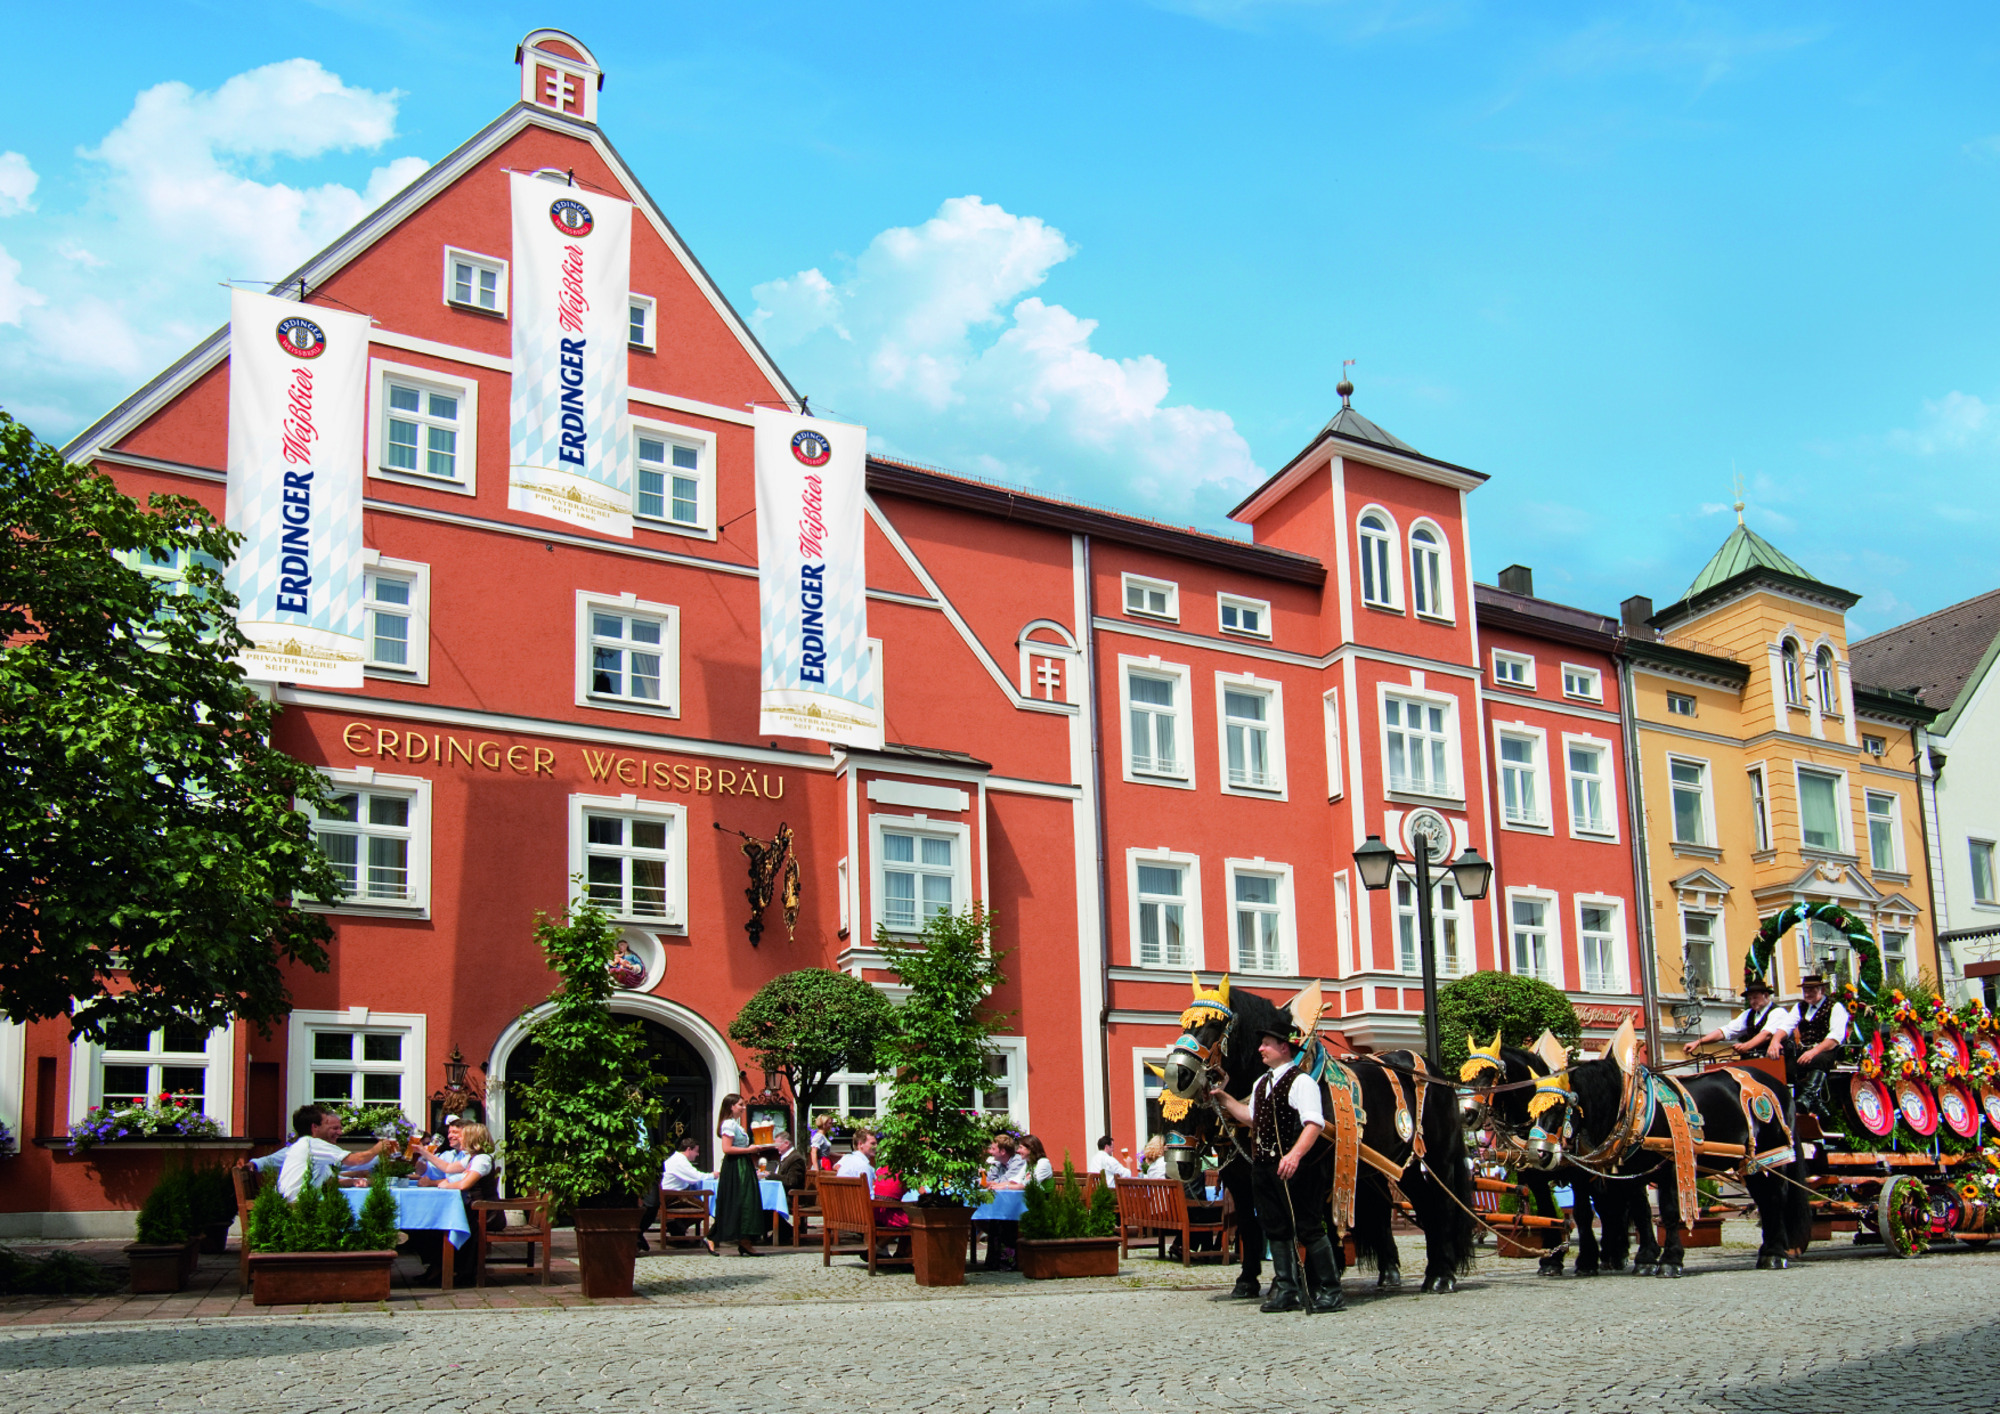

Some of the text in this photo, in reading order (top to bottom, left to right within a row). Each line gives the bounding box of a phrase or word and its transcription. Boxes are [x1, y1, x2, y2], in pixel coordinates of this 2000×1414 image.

[552, 201, 591, 220] ERDINGER
[279, 318, 323, 339] ERDINGER
[557, 244, 590, 467] ERDINGER Weißbier
[793, 431, 829, 449] ERDINGER
[276, 366, 319, 616] ERDINGER Weißbier
[535, 493, 611, 519] PRIVATBRAUEREI
[552, 504, 573, 515] SEIT
[798, 473, 829, 684] ERDINGER Weißbier
[246, 653, 337, 669] PRIVATBRAUEREI
[264, 663, 290, 672] SEIT
[779, 715, 853, 731] PRIVATBRAUEREI
[793, 723, 812, 731] SEIT
[342, 721, 785, 800] ERDINGER WEISSBRÄU
